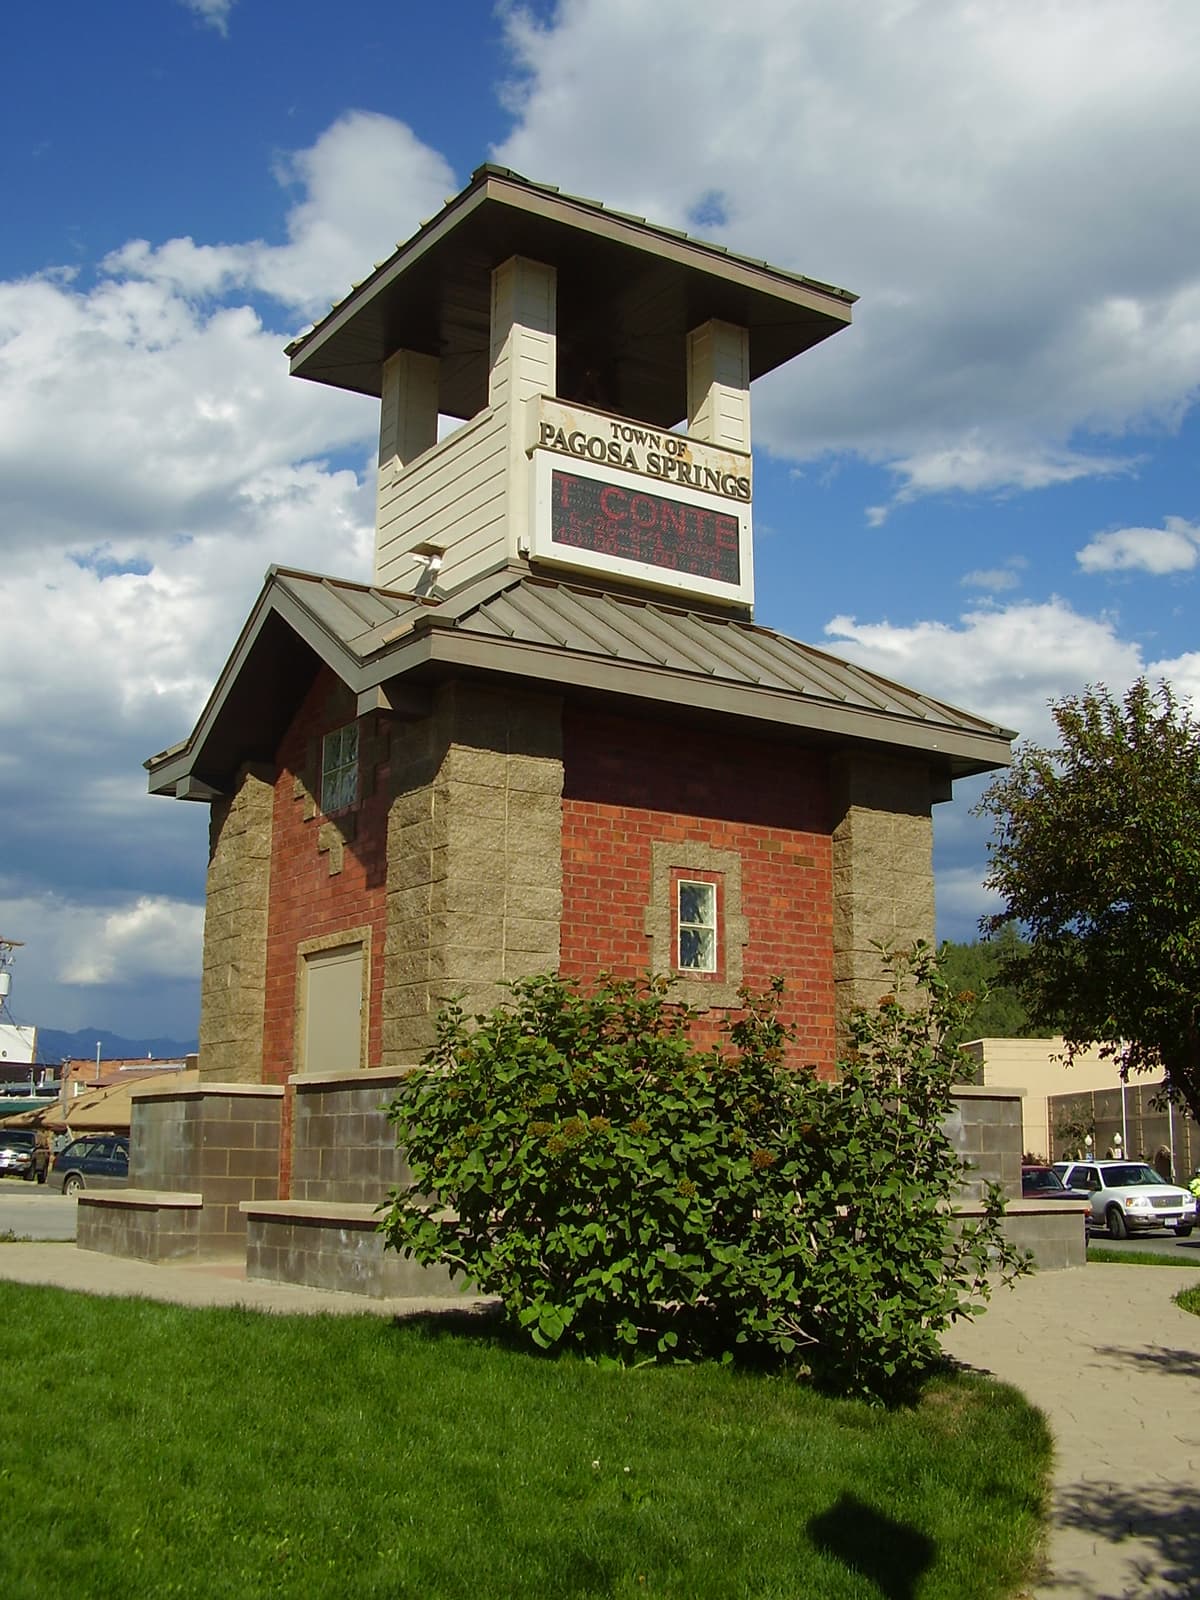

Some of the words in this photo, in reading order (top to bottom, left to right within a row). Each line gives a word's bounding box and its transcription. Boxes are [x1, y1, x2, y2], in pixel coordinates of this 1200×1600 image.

[539, 422, 639, 470] PAGOSA
[646, 452, 750, 500] SPRINGS
[609, 422, 661, 450] TOWN
[665, 439, 688, 457] OF
[600, 486, 738, 550] CONTE
